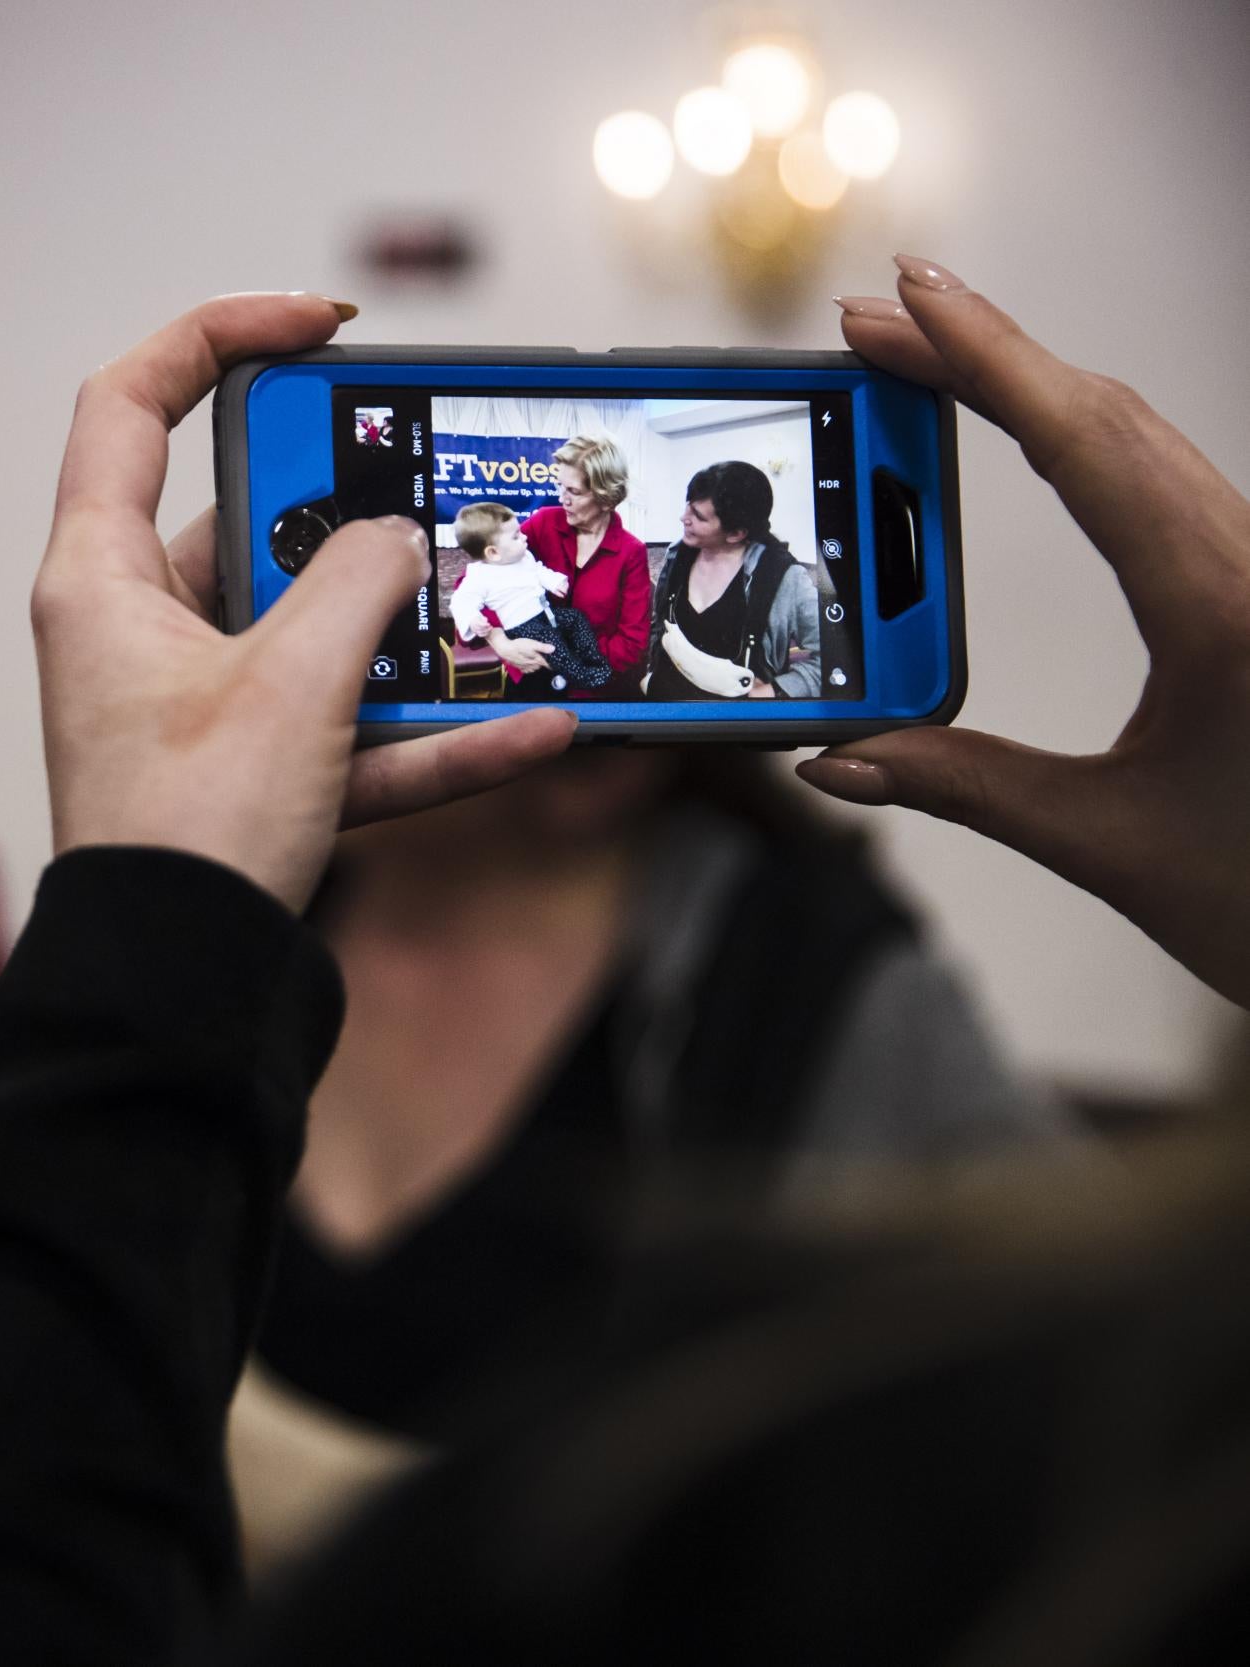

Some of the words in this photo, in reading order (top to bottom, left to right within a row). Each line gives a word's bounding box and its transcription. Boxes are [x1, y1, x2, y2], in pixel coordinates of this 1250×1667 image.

[412, 422, 423, 456] SLO-MO
[433, 453, 560, 483] FTvotes
[413, 474, 425, 508] VIDEO
[449, 487, 461, 495] We
[463, 487, 485, 496] Fight.
[521, 489, 533, 497] Up.
[819, 479, 840, 489] HDR
[420, 650, 431, 674] PANO
